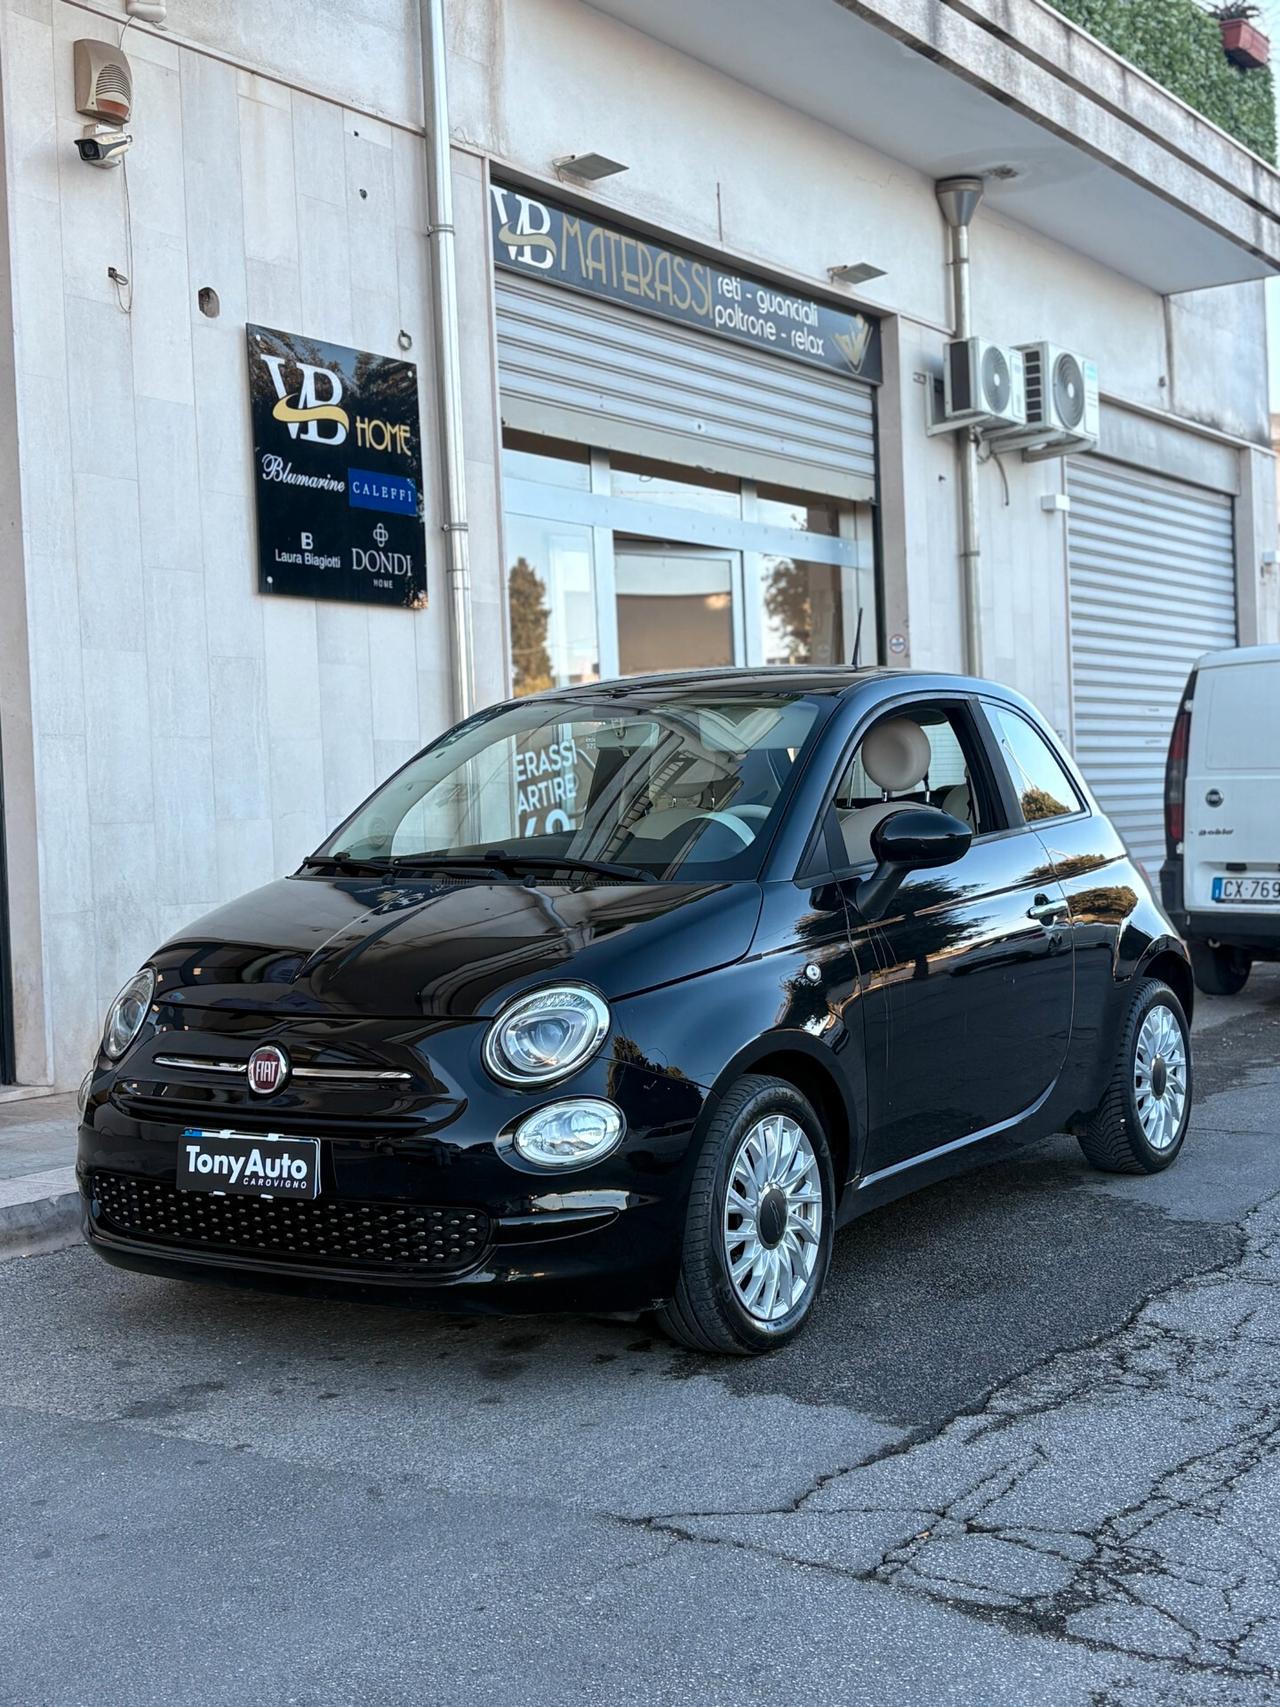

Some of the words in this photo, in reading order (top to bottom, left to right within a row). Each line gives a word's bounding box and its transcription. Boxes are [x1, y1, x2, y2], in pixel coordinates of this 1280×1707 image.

[560, 213, 713, 321] MATERASSI
[717, 276, 742, 300] reti
[757, 290, 819, 327] guanciali
[715, 303, 776, 341] poltrone
[791, 328, 825, 357] relax
[355, 415, 412, 456] HOME
[261, 453, 345, 493] Blumarine
[352, 481, 413, 502] CALEFFI
[275, 549, 303, 564] Laura
[304, 553, 341, 570] Biagiotti
[351, 548, 413, 577] DONDI
[373, 579, 394, 589] HOME
[513, 739, 578, 783] ERASSI
[517, 773, 577, 816] ARTIRE
[255, 1060, 279, 1083] FIAT
[185, 1145, 308, 1184] TonyAuto
[243, 1177, 307, 1189] CAROVIGNO
